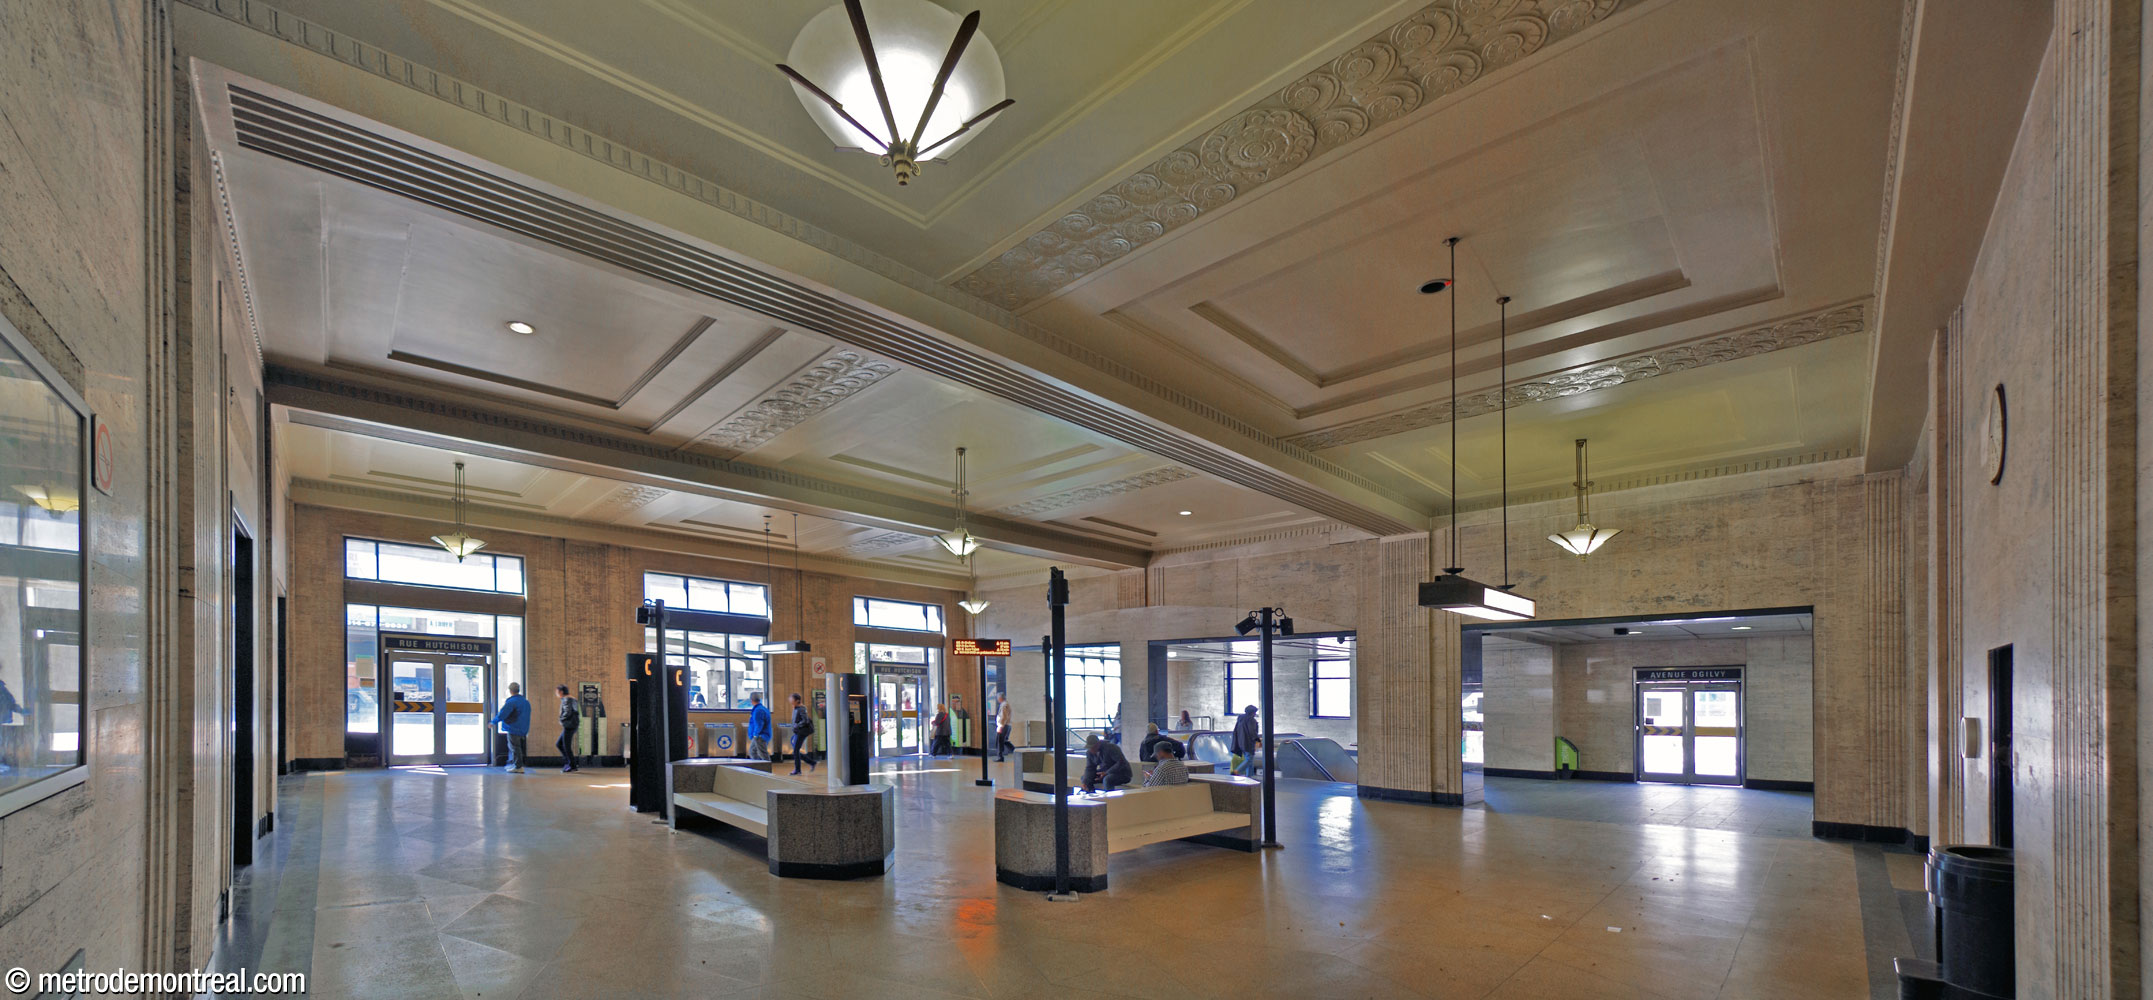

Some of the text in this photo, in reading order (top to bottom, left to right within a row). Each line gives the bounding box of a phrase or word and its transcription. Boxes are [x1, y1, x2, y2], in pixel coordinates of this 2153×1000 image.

[399, 639, 480, 651] RUE HUTCHISON
[1650, 671, 1686, 679] AVENUE
